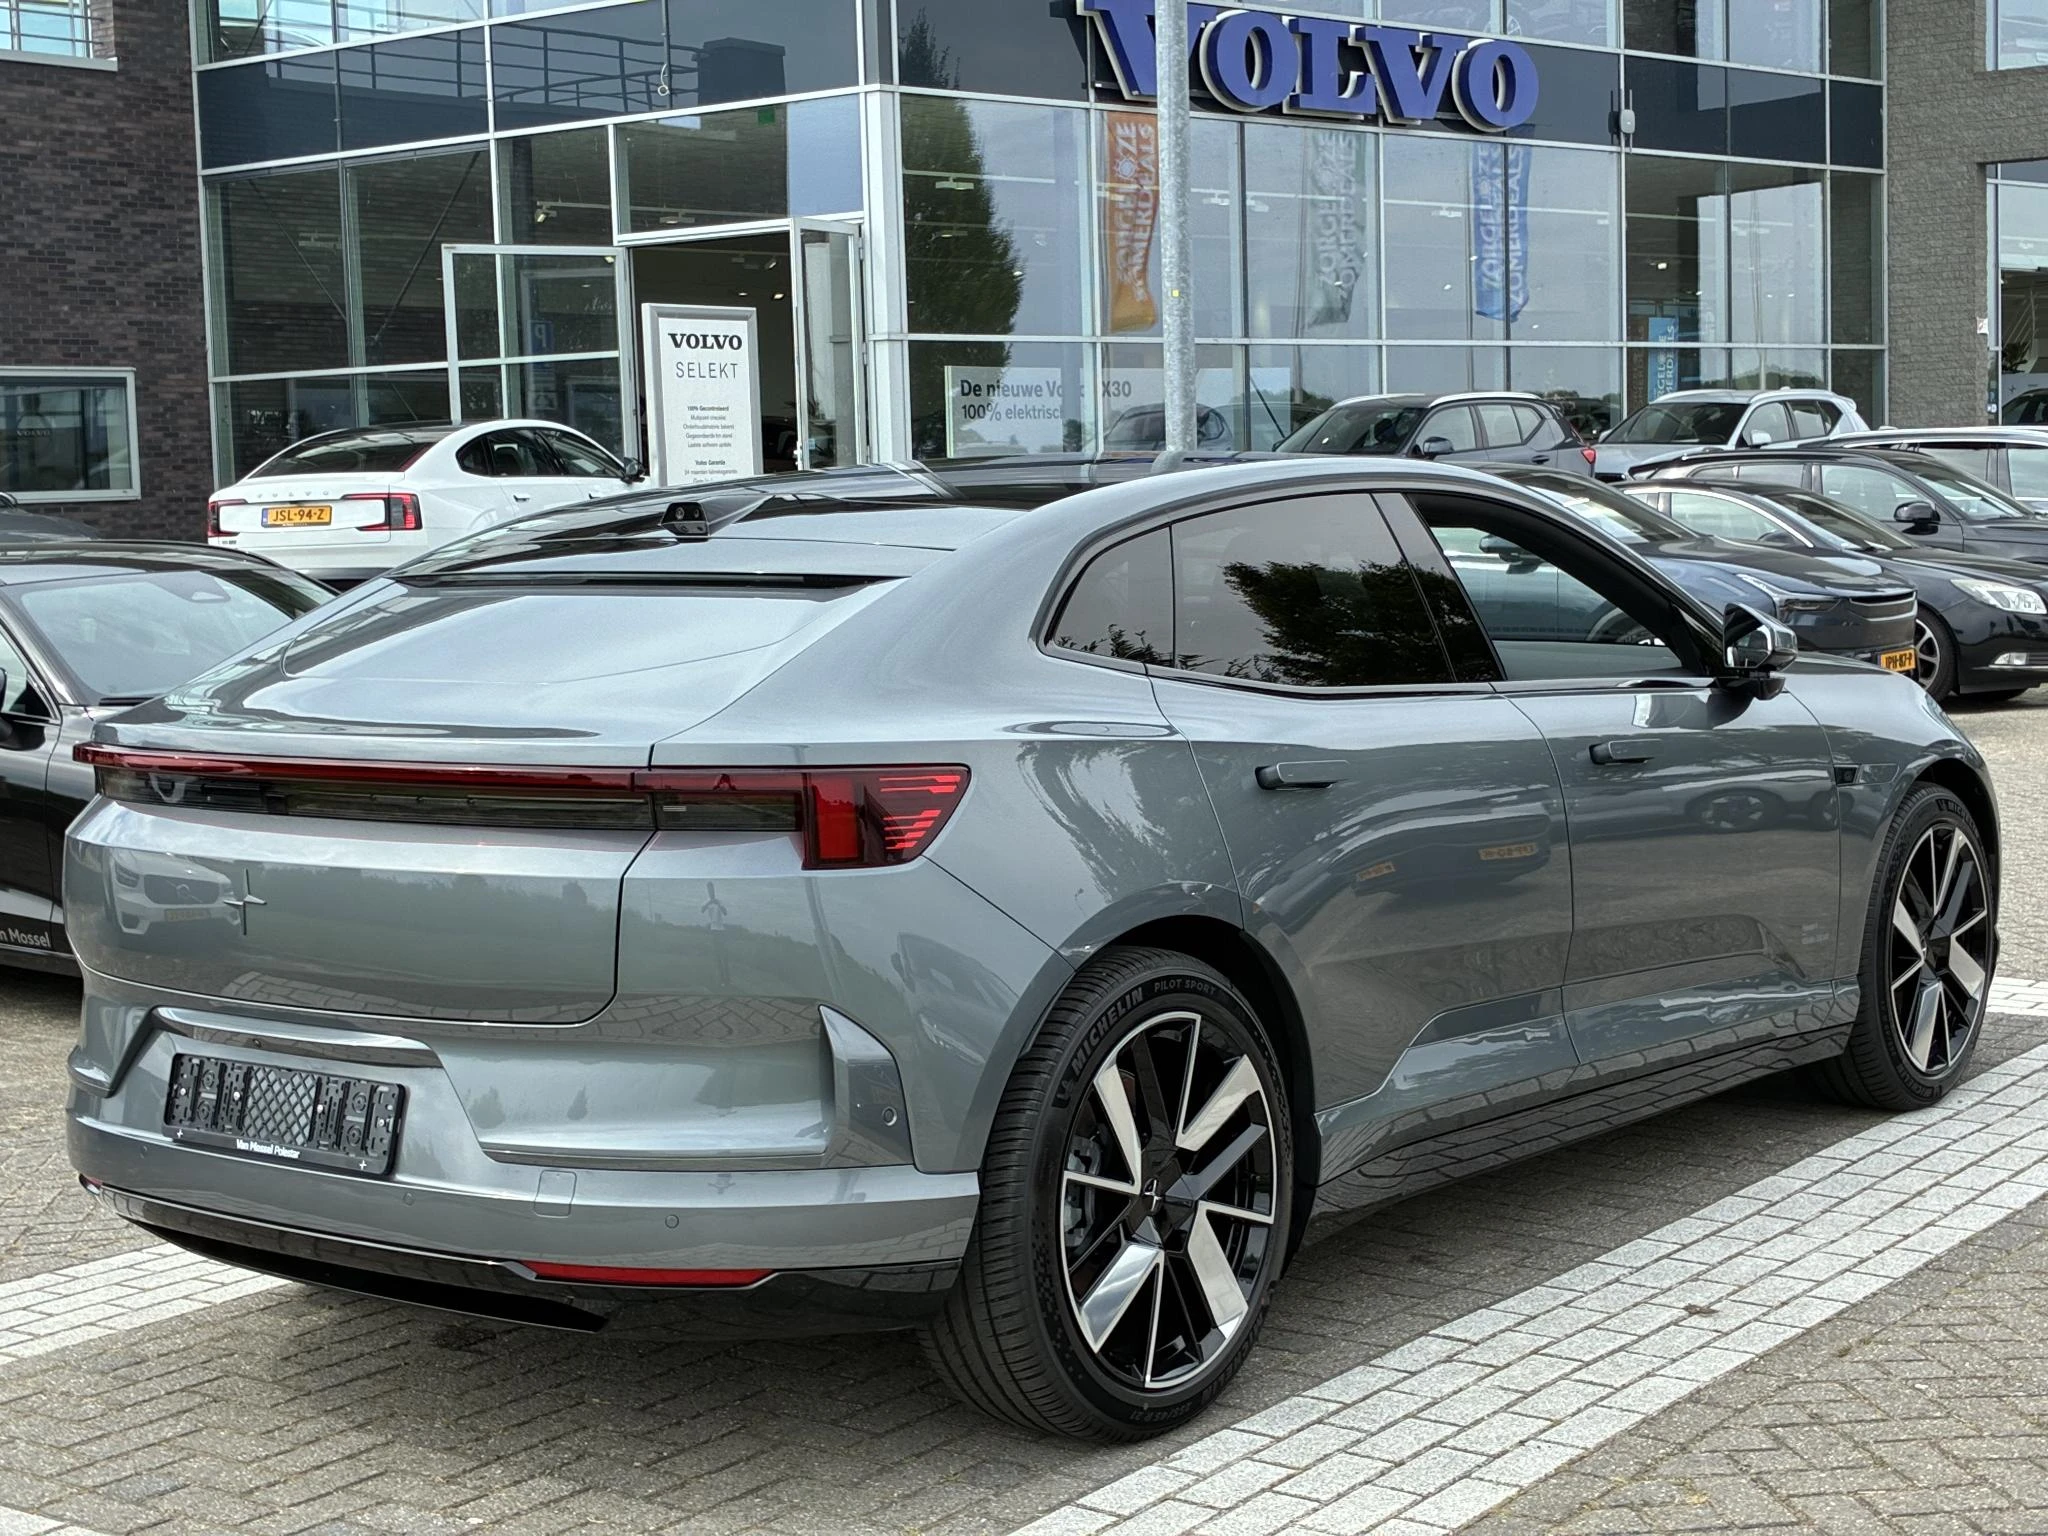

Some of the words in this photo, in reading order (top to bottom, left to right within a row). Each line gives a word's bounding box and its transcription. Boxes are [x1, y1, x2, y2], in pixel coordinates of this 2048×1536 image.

[1084, 0, 1539, 132] VOLVO
[668, 332, 743, 351] VOLVO
[675, 361, 739, 379] SELEKT
[960, 380, 982, 397] De
[986, 379, 1043, 398] nieuwe
[1102, 380, 1132, 398] X30
[962, 404, 1002, 422] 100%
[272, 509, 324, 522] JSL-94-Z
[8, 928, 52, 948] Mossel
[1071, 986, 1144, 1077] MICHELIN
[1154, 978, 1183, 993] PILOT
[1185, 979, 1216, 995] SPORT
